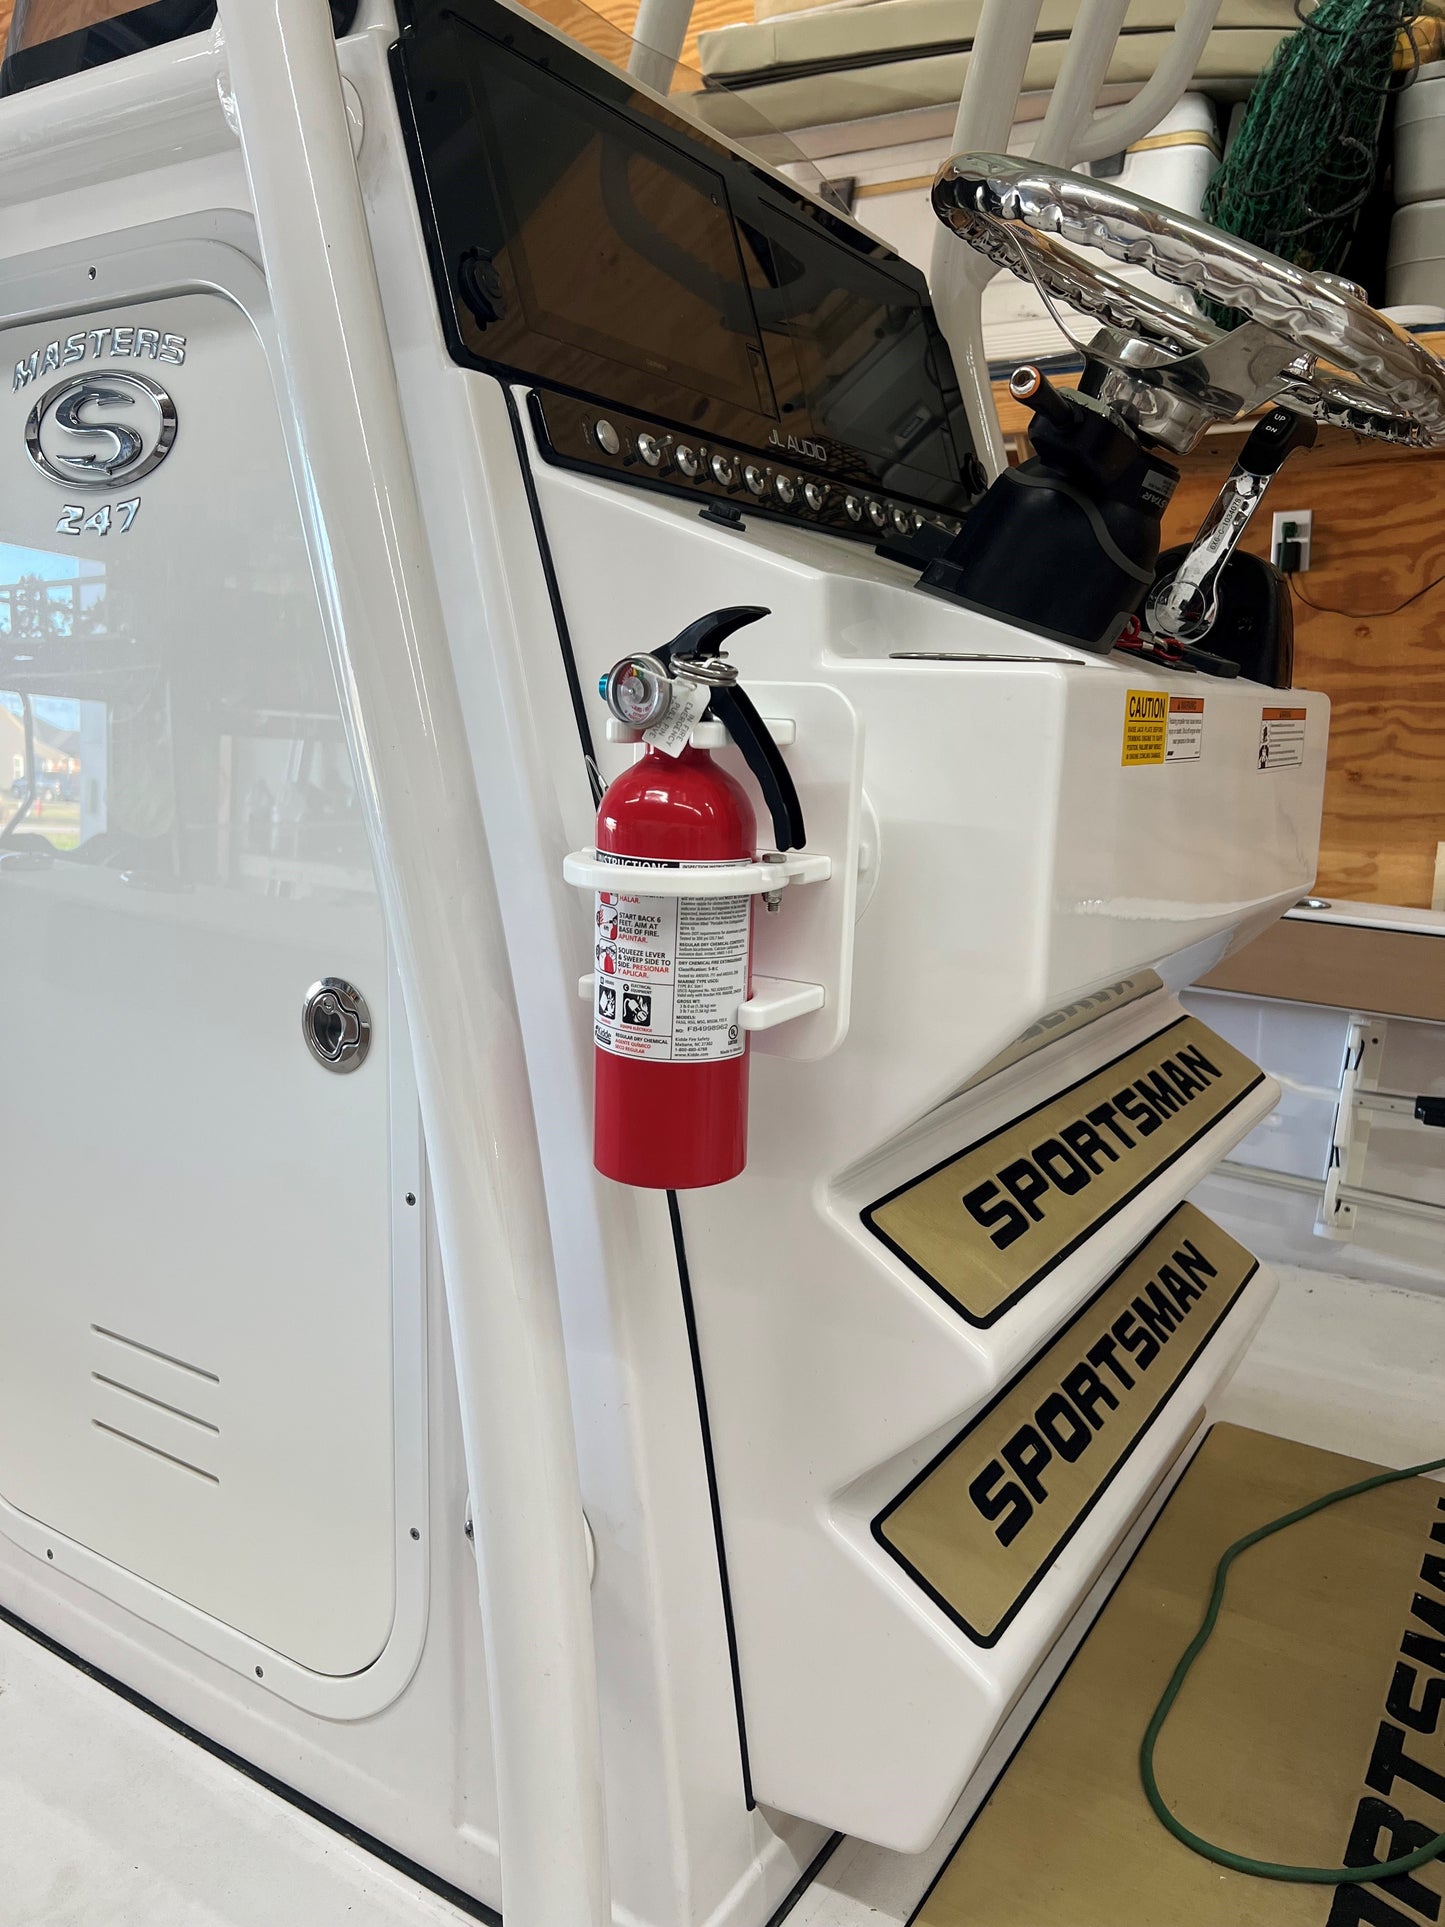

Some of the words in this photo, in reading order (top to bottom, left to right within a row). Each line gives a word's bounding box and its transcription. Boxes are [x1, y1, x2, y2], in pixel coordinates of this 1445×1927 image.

[12, 327, 187, 393] MASTERS
[1274, 414, 1286, 422] UP
[768, 429, 785, 448] JL
[788, 434, 827, 462] AUDIO
[55, 497, 141, 536] 247
[666, 703, 680, 721] PULL
[1129, 696, 1165, 718] CAUTION
[666, 702, 693, 747] EMERGENCY
[687, 713, 695, 722] IN
[658, 724, 669, 736] PIN
[676, 725, 689, 742] FIRE
[618, 934, 648, 943] APUNTAR.
[618, 947, 644, 956] SQUEEZE
[646, 950, 666, 958] LEVER
[624, 955, 644, 963] SWEEP
[622, 970, 649, 978] APLICAR.
[632, 964, 669, 973] PRESIONAR
[962, 1044, 1223, 1250] SPORTSMAN
[968, 1239, 1218, 1548] SPORTSMAN
